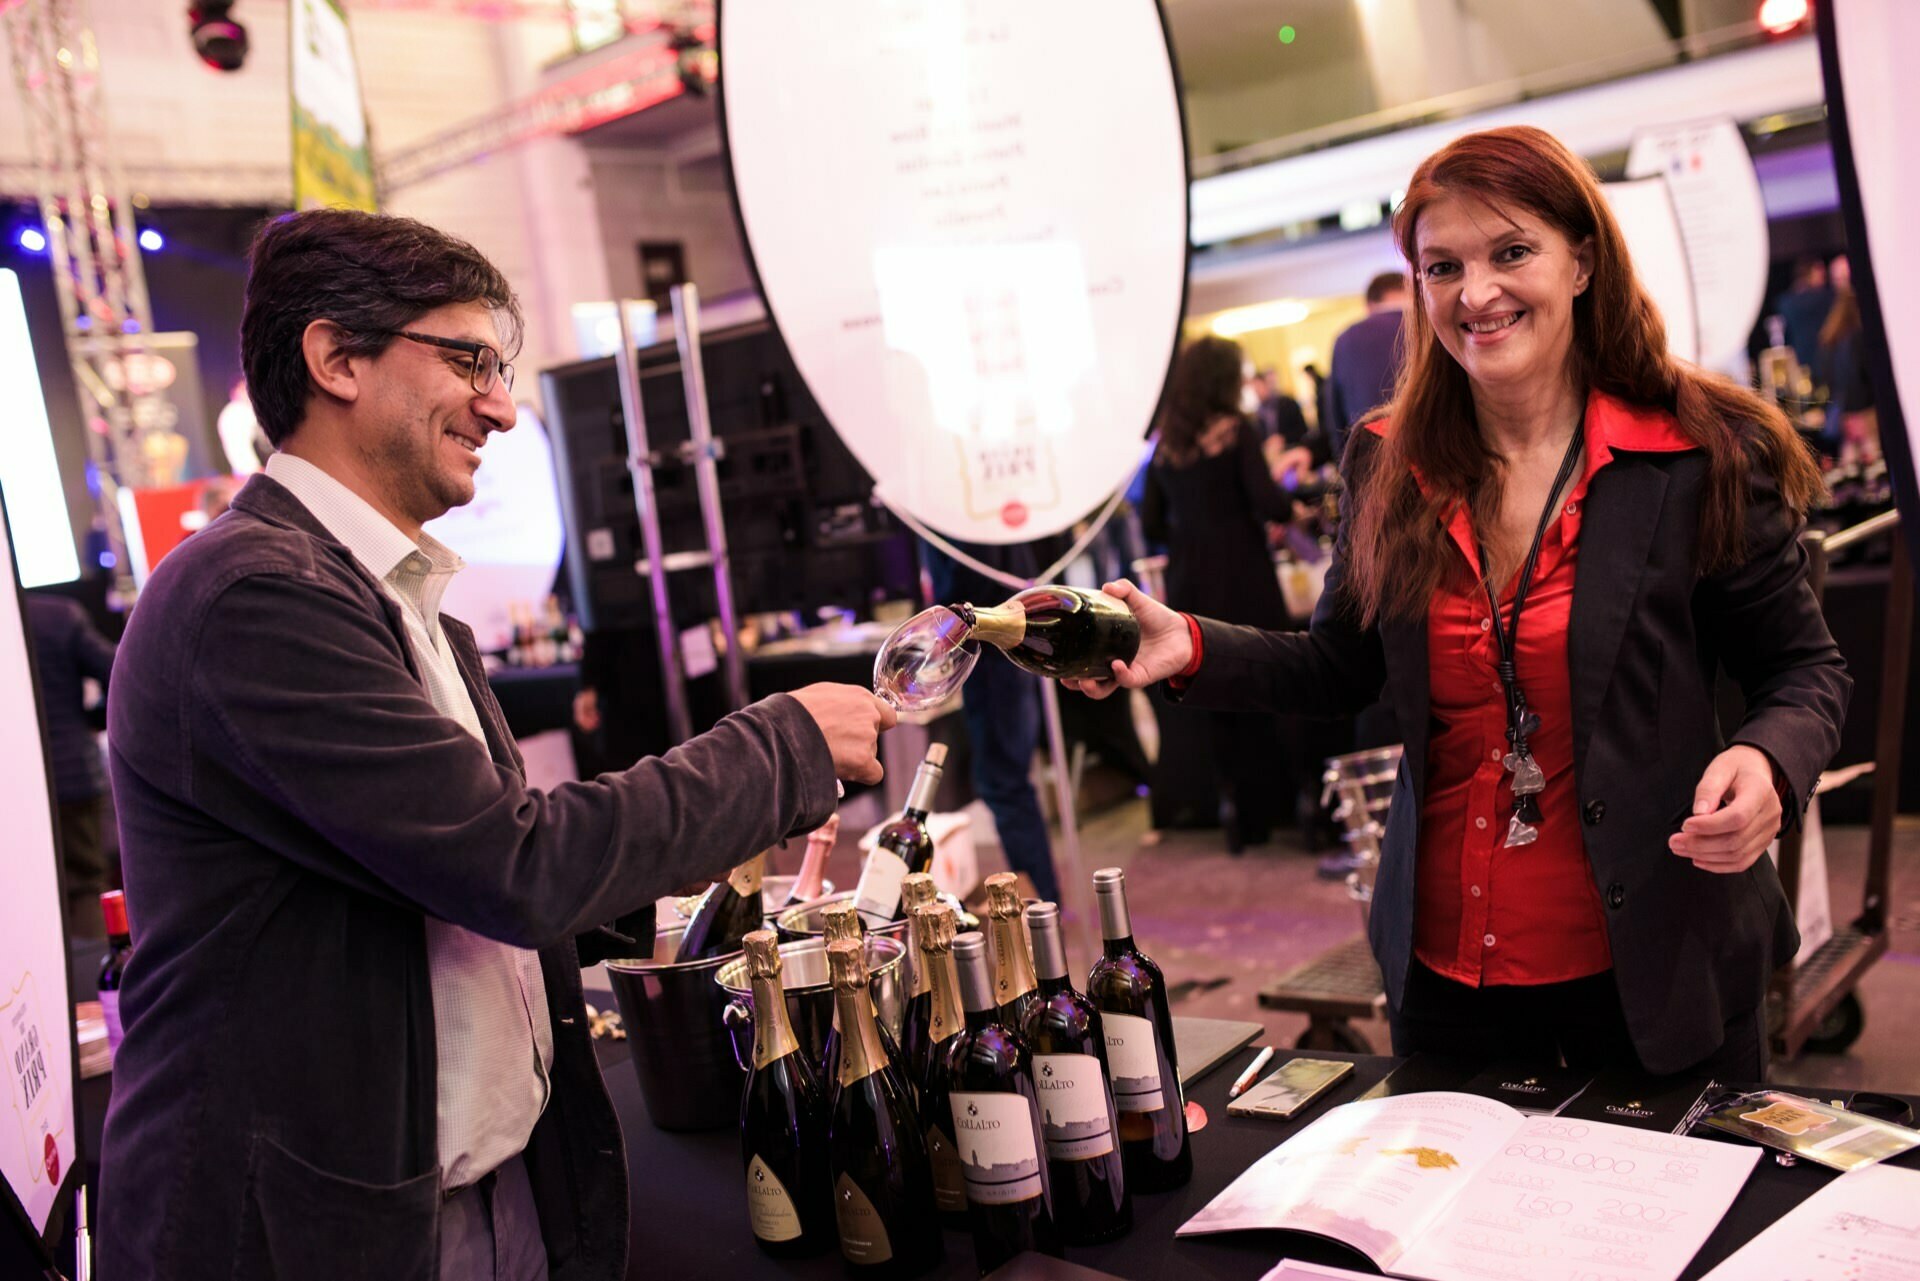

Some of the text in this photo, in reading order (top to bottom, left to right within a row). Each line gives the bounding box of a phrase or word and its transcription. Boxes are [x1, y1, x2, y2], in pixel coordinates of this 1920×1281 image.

[1605, 1104, 1655, 1116] COLLALTO
[957, 1117, 1001, 1130] COLLALTO
[1528, 1120, 1590, 1139] 250
[1504, 1143, 1637, 1175] 600.000
[1514, 1193, 1575, 1216] 150
[1597, 1198, 1690, 1224] 2007
